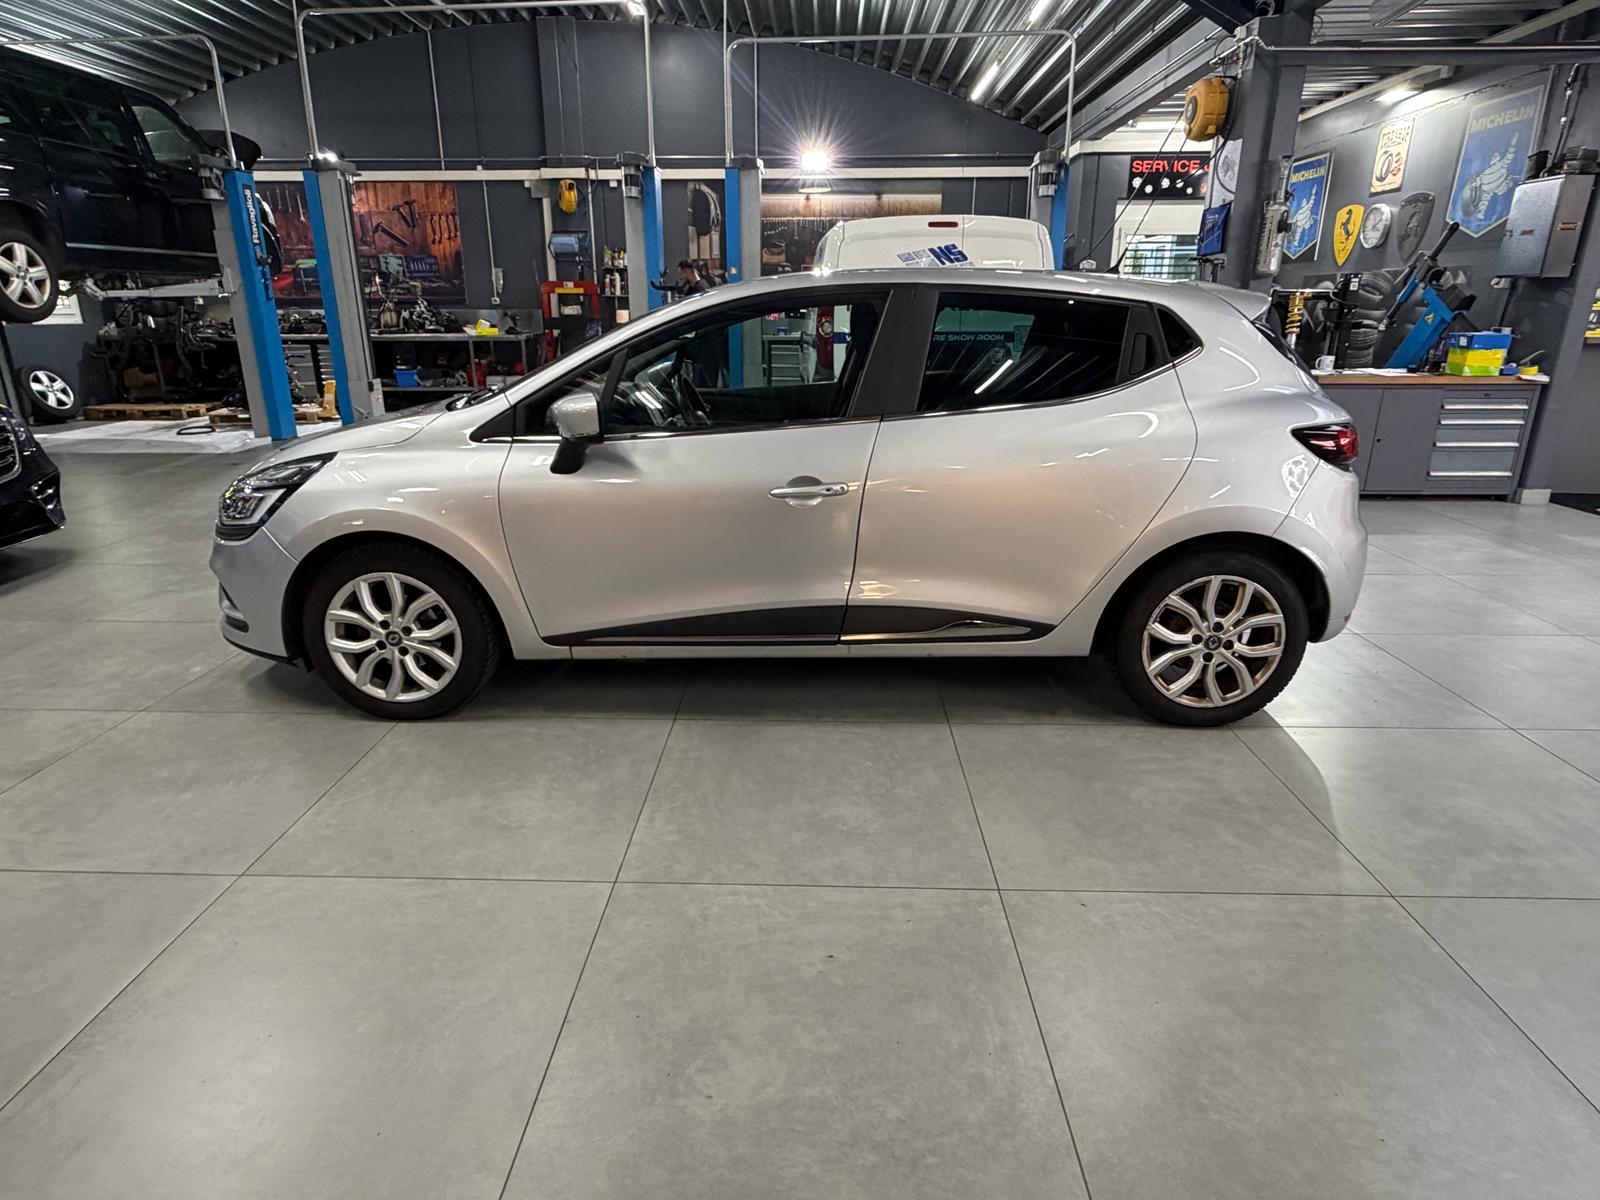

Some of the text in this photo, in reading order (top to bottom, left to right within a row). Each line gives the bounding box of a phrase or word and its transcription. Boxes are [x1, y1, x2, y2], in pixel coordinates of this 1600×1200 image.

[1470, 104, 1536, 132] MICHELIN
[1132, 160, 1200, 173] SERVICE
[1290, 166, 1328, 183] MICHELIN
[244, 189, 259, 243] Ravaglioli
